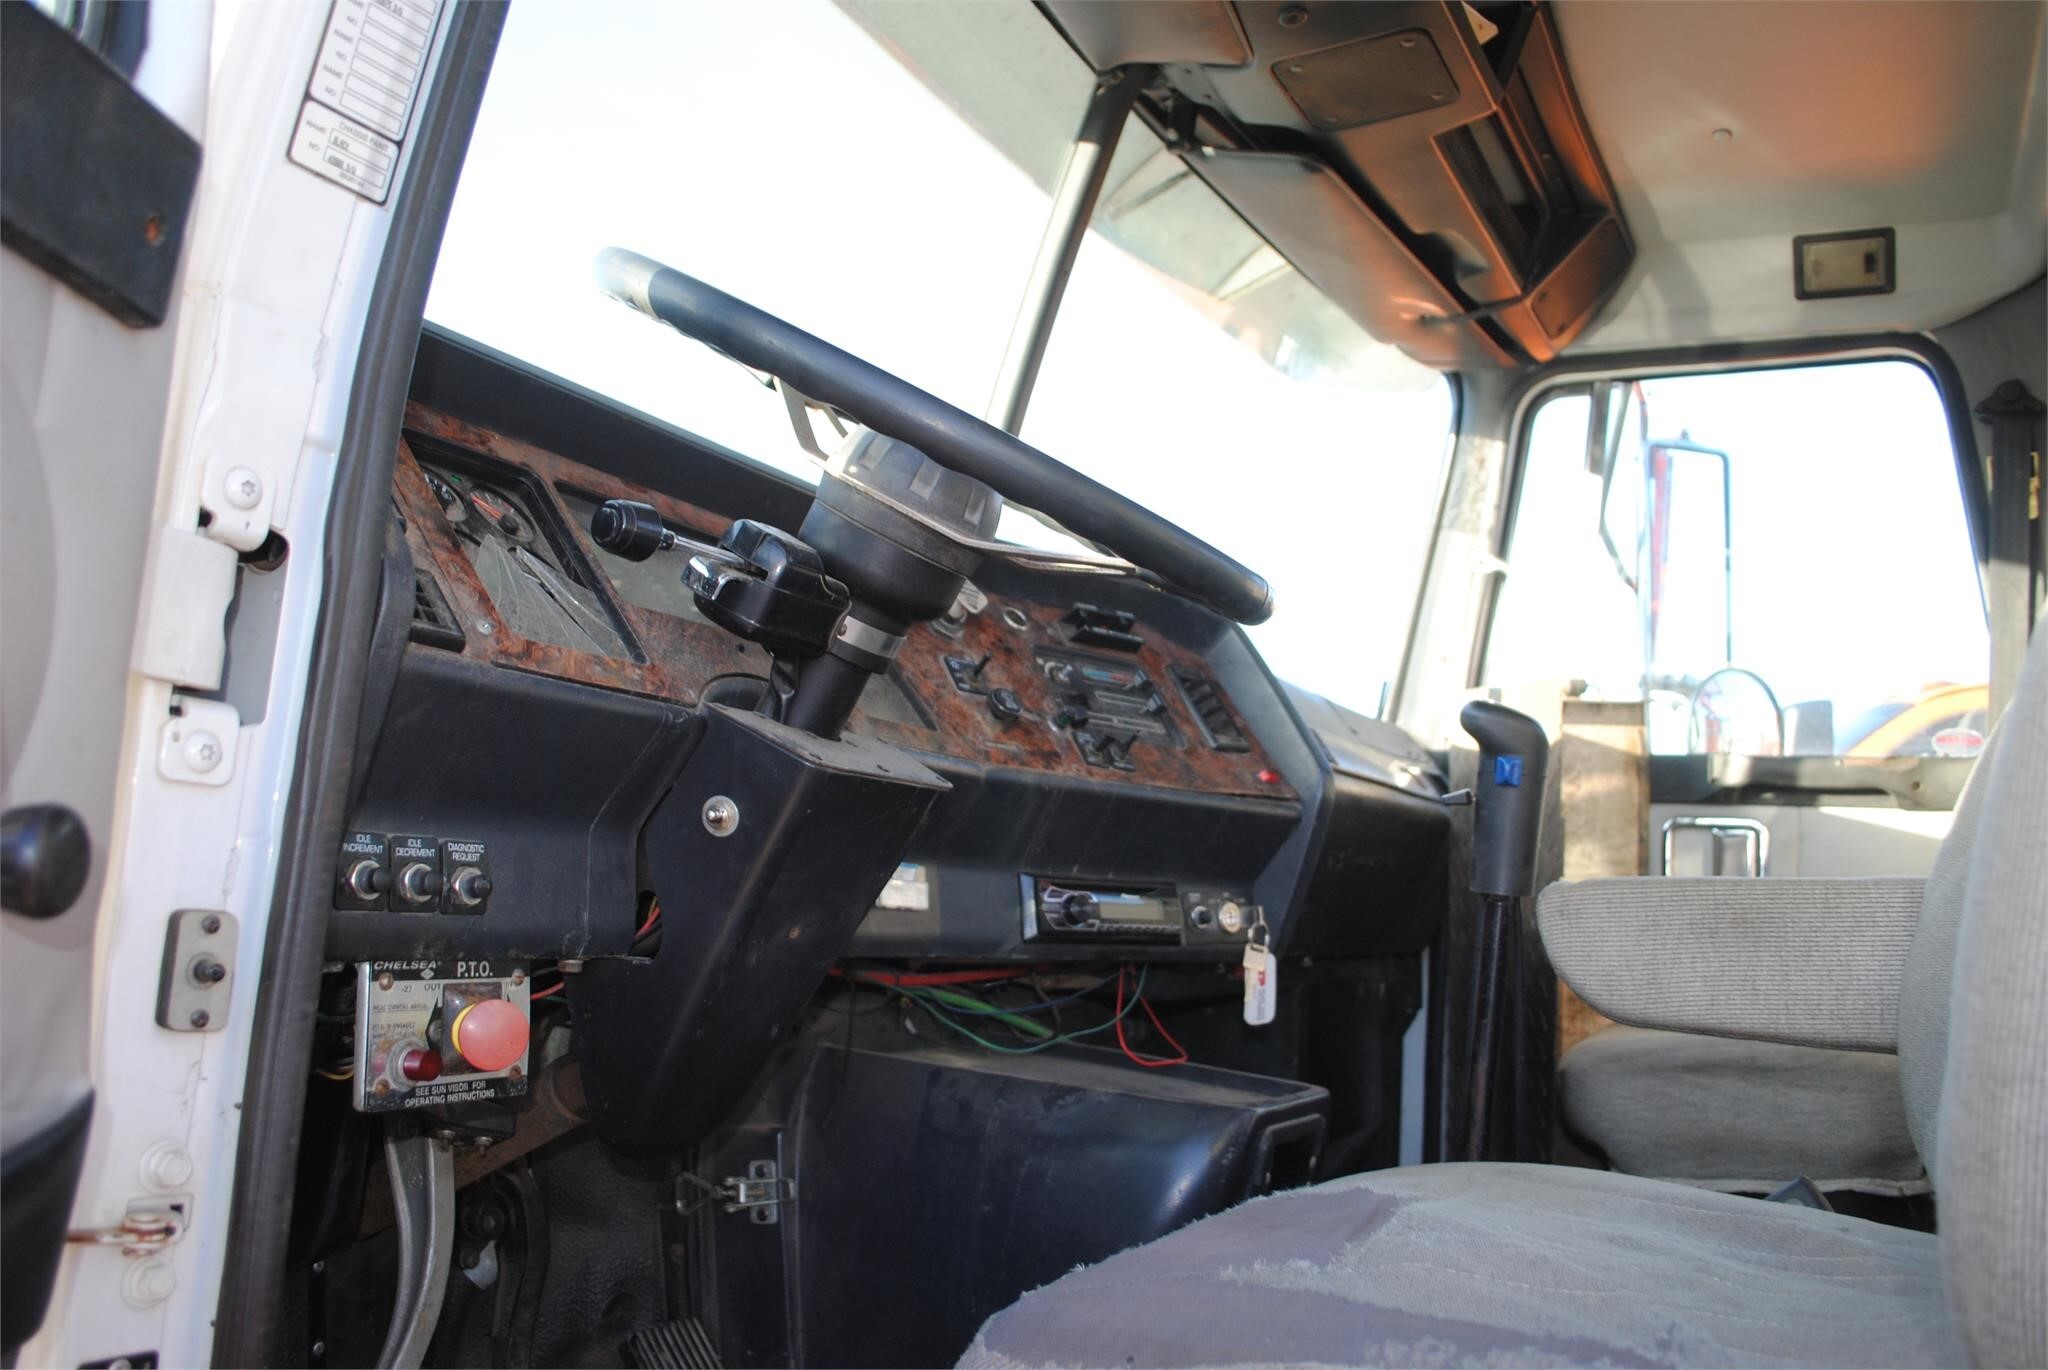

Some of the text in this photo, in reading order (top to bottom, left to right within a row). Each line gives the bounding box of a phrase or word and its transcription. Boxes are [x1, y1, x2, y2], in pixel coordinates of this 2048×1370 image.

[356, 834, 372, 844] IDLE
[407, 838, 422, 848] IDLE
[343, 843, 384, 854] INCREMENT
[395, 847, 436, 858] DECREMENT
[447, 842, 485, 854] DIAGNOSTIC
[452, 852, 481, 863] REQUEST
[457, 961, 493, 977] P.T.O.
[424, 983, 441, 992] OUT
[415, 1081, 487, 1097] SEE SUN VISOR FOR
[405, 1088, 495, 1108] OPERATING INSTRUCTIONS
